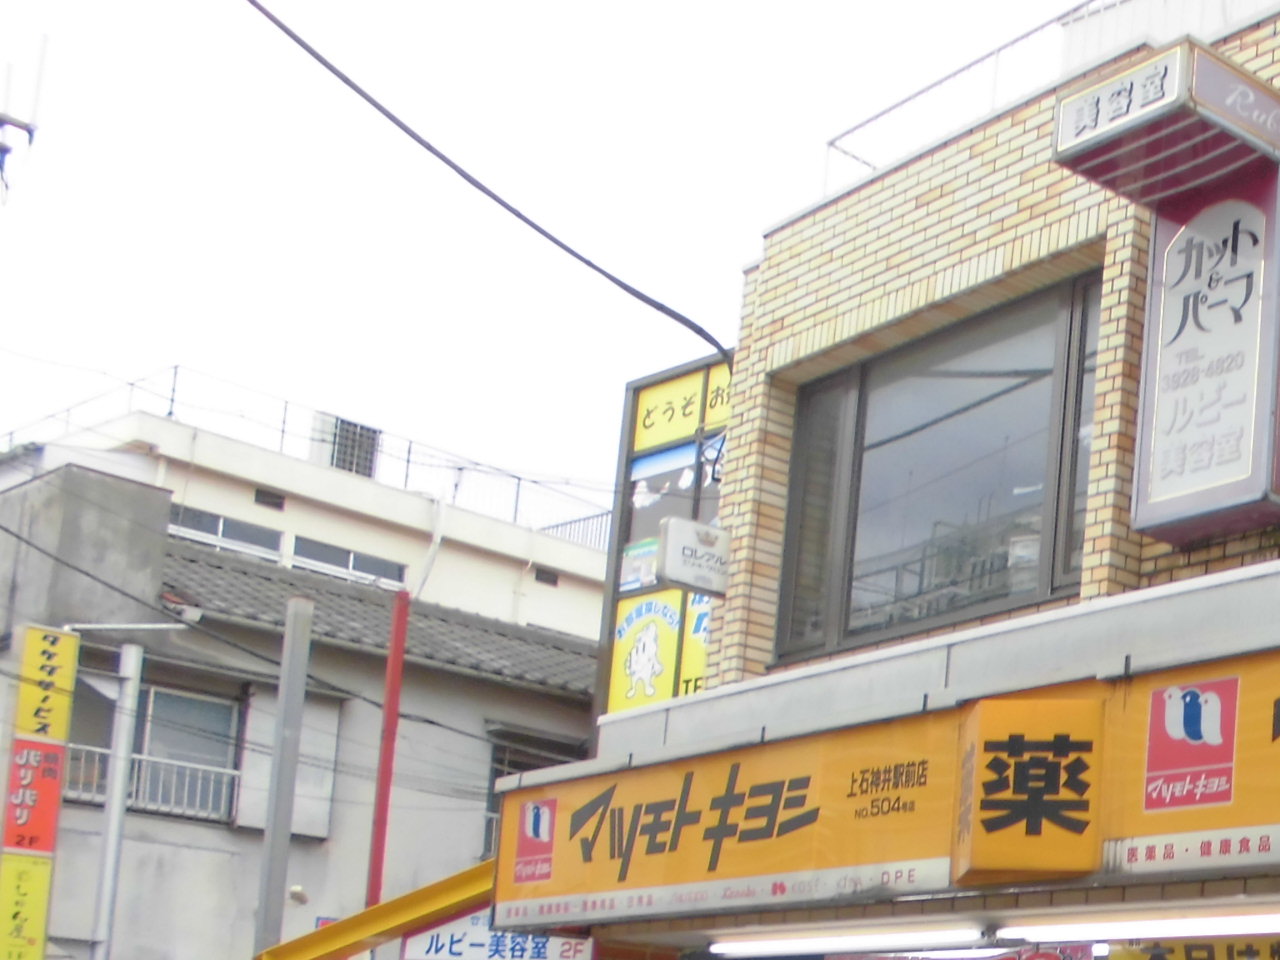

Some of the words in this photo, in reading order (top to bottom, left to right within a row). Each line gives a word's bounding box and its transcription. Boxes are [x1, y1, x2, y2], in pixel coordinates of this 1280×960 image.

[1169, 218, 1260, 290] カット
[1207, 269, 1224, 291] &
[1165, 270, 1256, 348] パーマ
[642, 393, 698, 431] どうぞ
[1162, 380, 1248, 437] ルビー
[681, 545, 728, 567] ロレアル
[12, 750, 42, 825] バリバリ
[846, 759, 929, 799] 上石神井駅前店
[979, 733, 1094, 836] 薬
[1147, 774, 1231, 803] マツモトキヨシ
[16, 835, 39, 847] 2F
[569, 762, 821, 882] マツモトキヨシ
[425, 932, 551, 960] ルビー美容室
[560, 941, 586, 960] 2F
